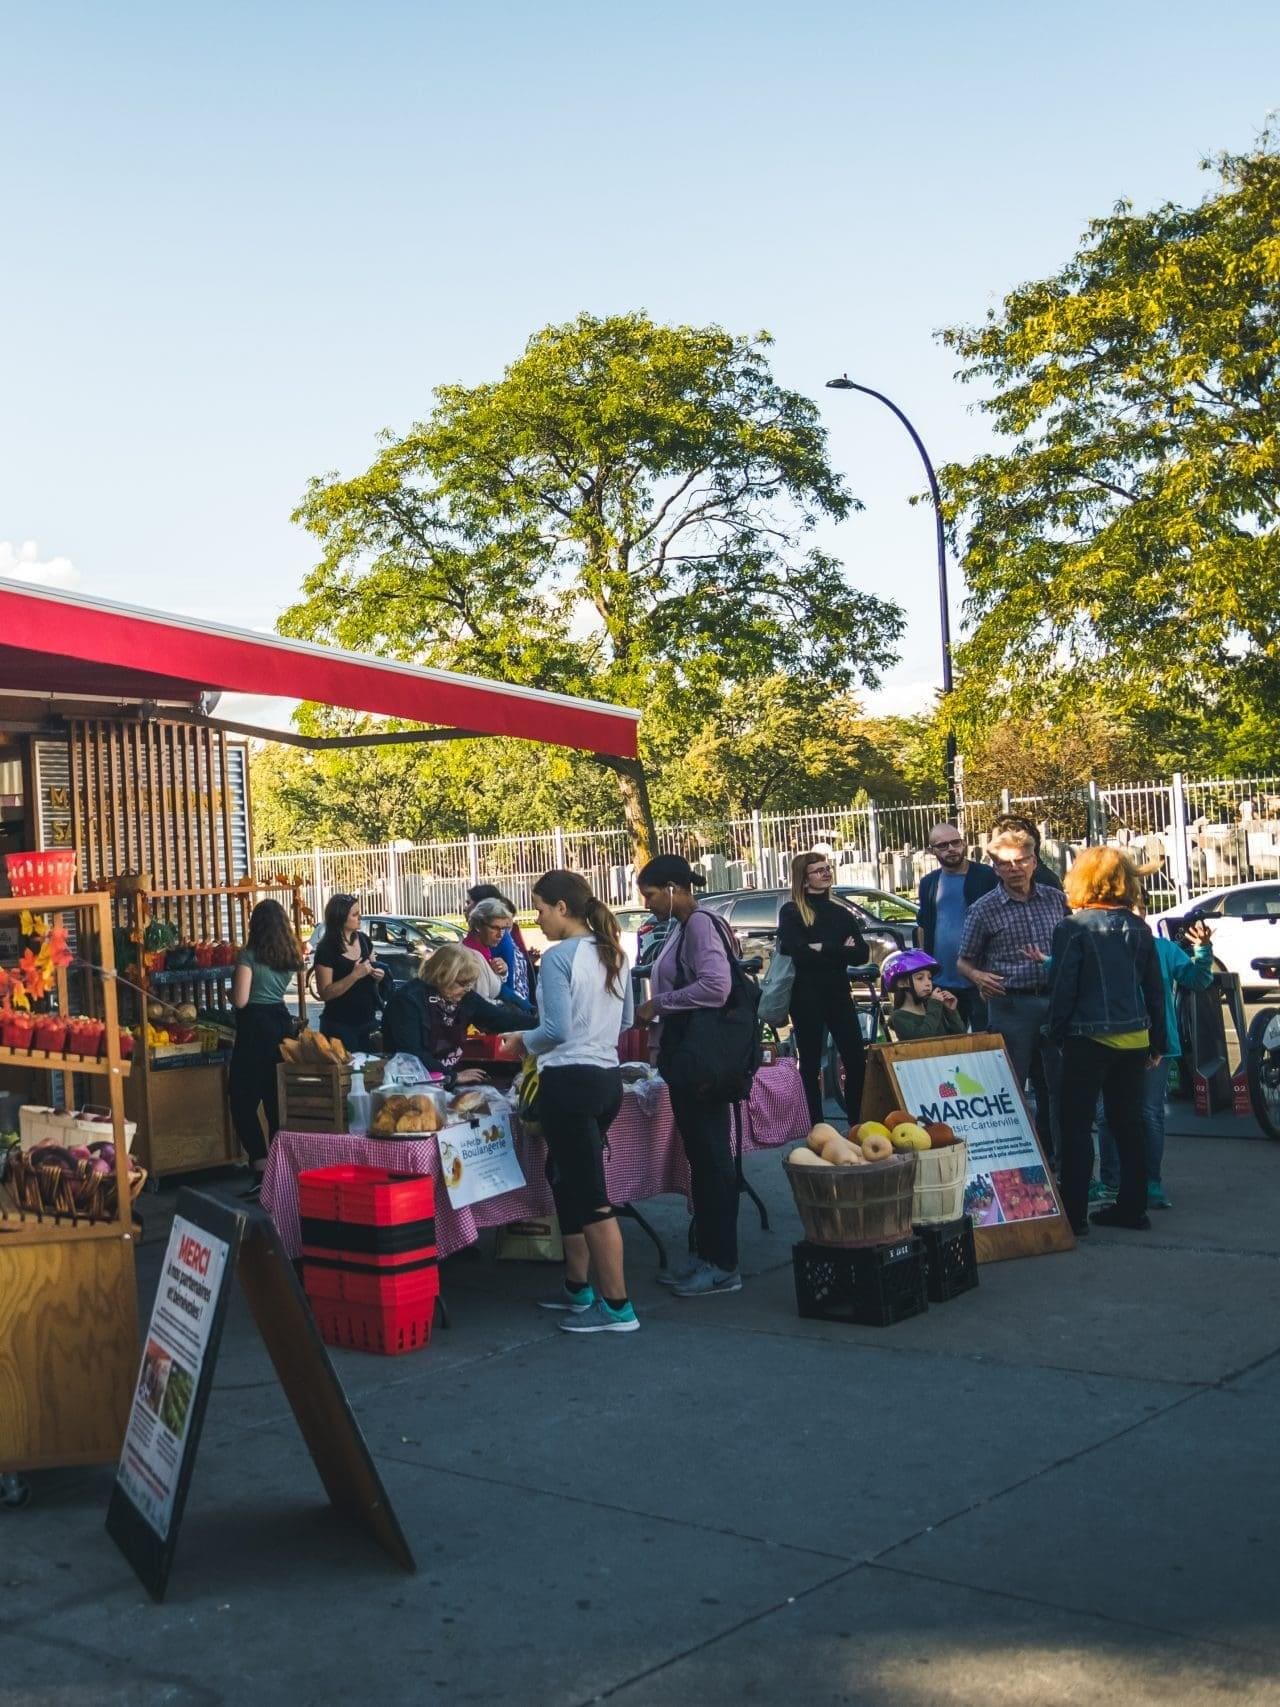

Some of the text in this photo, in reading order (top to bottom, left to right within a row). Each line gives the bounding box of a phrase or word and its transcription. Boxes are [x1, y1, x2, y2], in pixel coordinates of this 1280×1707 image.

[919, 1087, 1016, 1123] MARCHÉ
[462, 1139, 506, 1159] Boulangerie
[178, 1234, 211, 1276] MERCI
